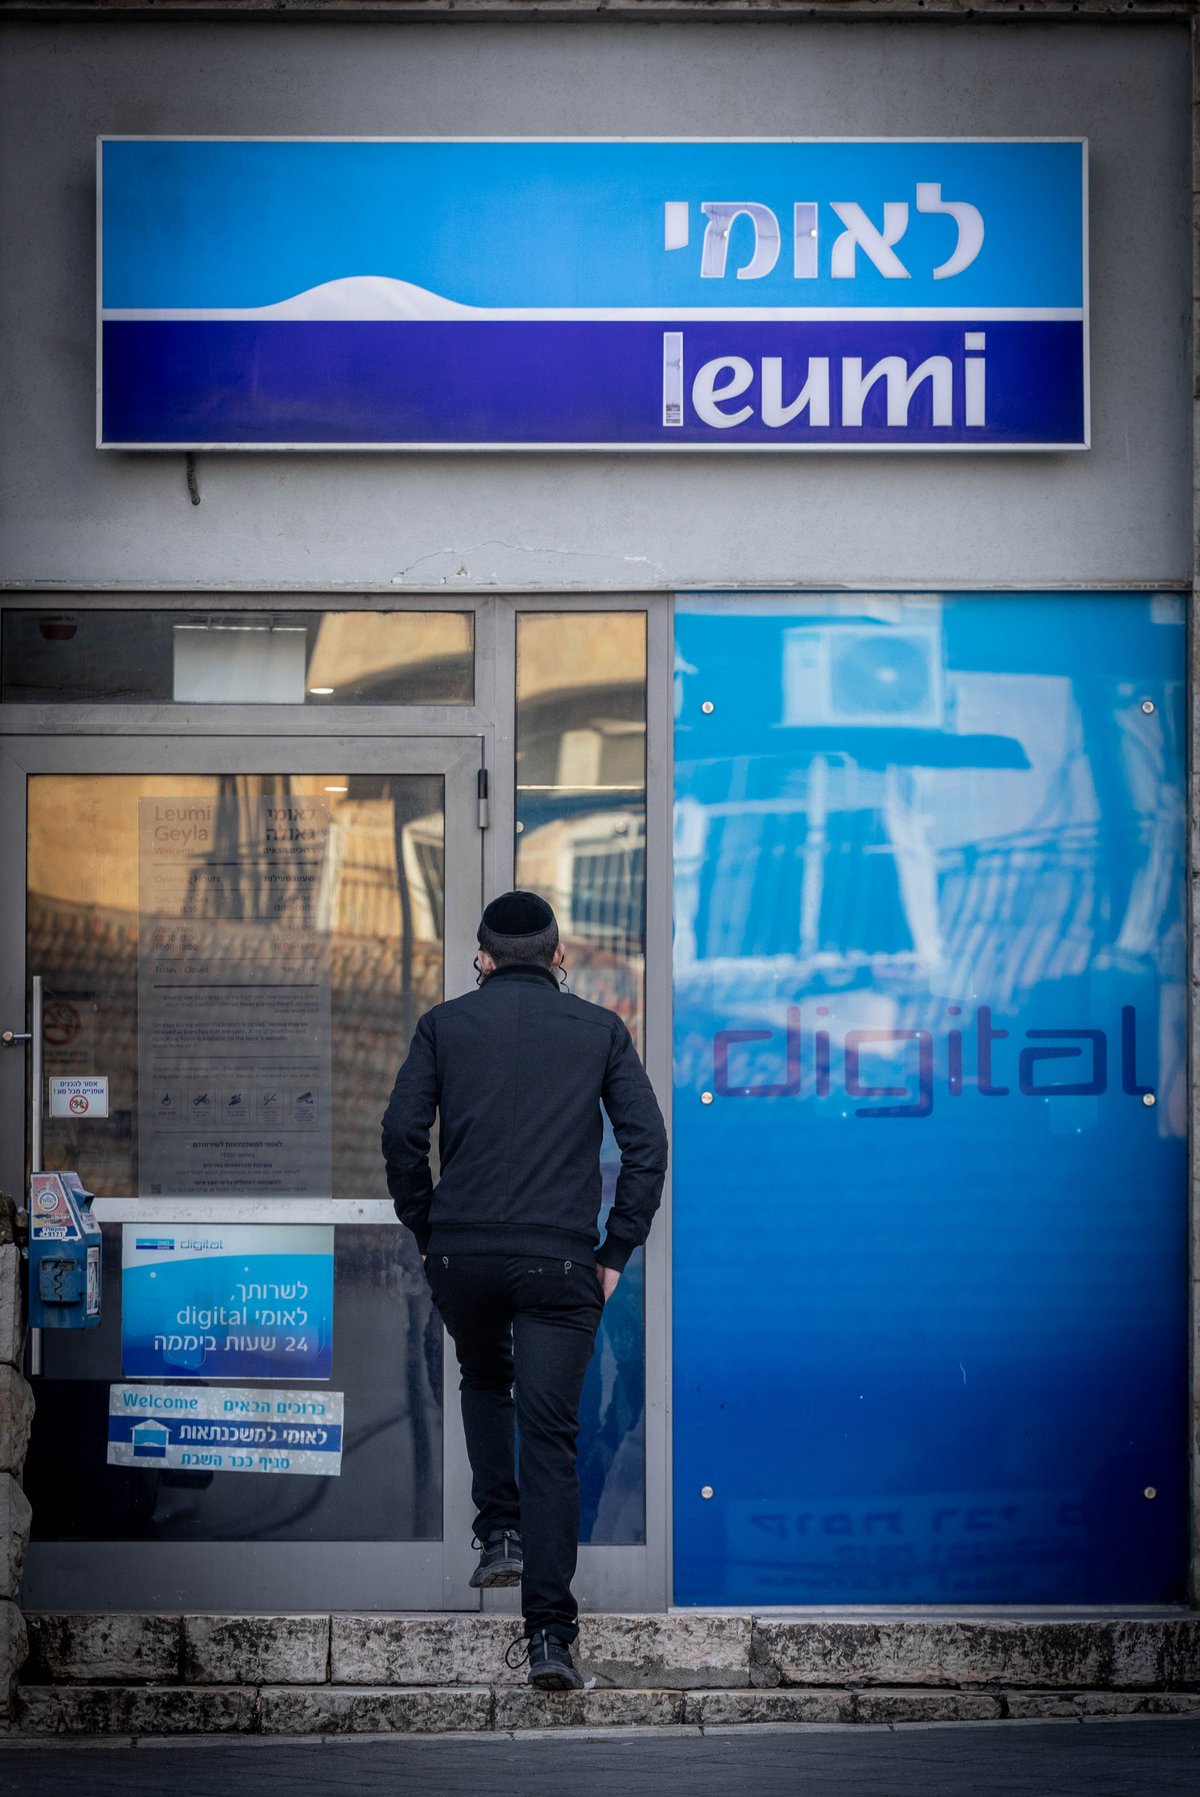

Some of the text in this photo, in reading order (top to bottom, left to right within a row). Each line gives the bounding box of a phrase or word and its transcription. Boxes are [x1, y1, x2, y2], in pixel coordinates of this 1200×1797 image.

[664, 182, 985, 280] לאומי
[663, 332, 986, 429] leumi
[155, 805, 211, 821] Leumi
[267, 806, 316, 821] לאומי
[154, 825, 209, 845] Geyla
[713, 1005, 1155, 1118] digital
[180, 1239, 224, 1251] digital
[231, 1281, 309, 1303] לשרותך,
[176, 1306, 308, 1329] לאומי digital
[154, 1335, 308, 1352] 24 שעות ביממה
[123, 1393, 326, 1415] Welcome ברוכים הבאים
[179, 1424, 328, 1445] לאומי למשכנתאות
[181, 1452, 290, 1470] סניף ככר השבת
